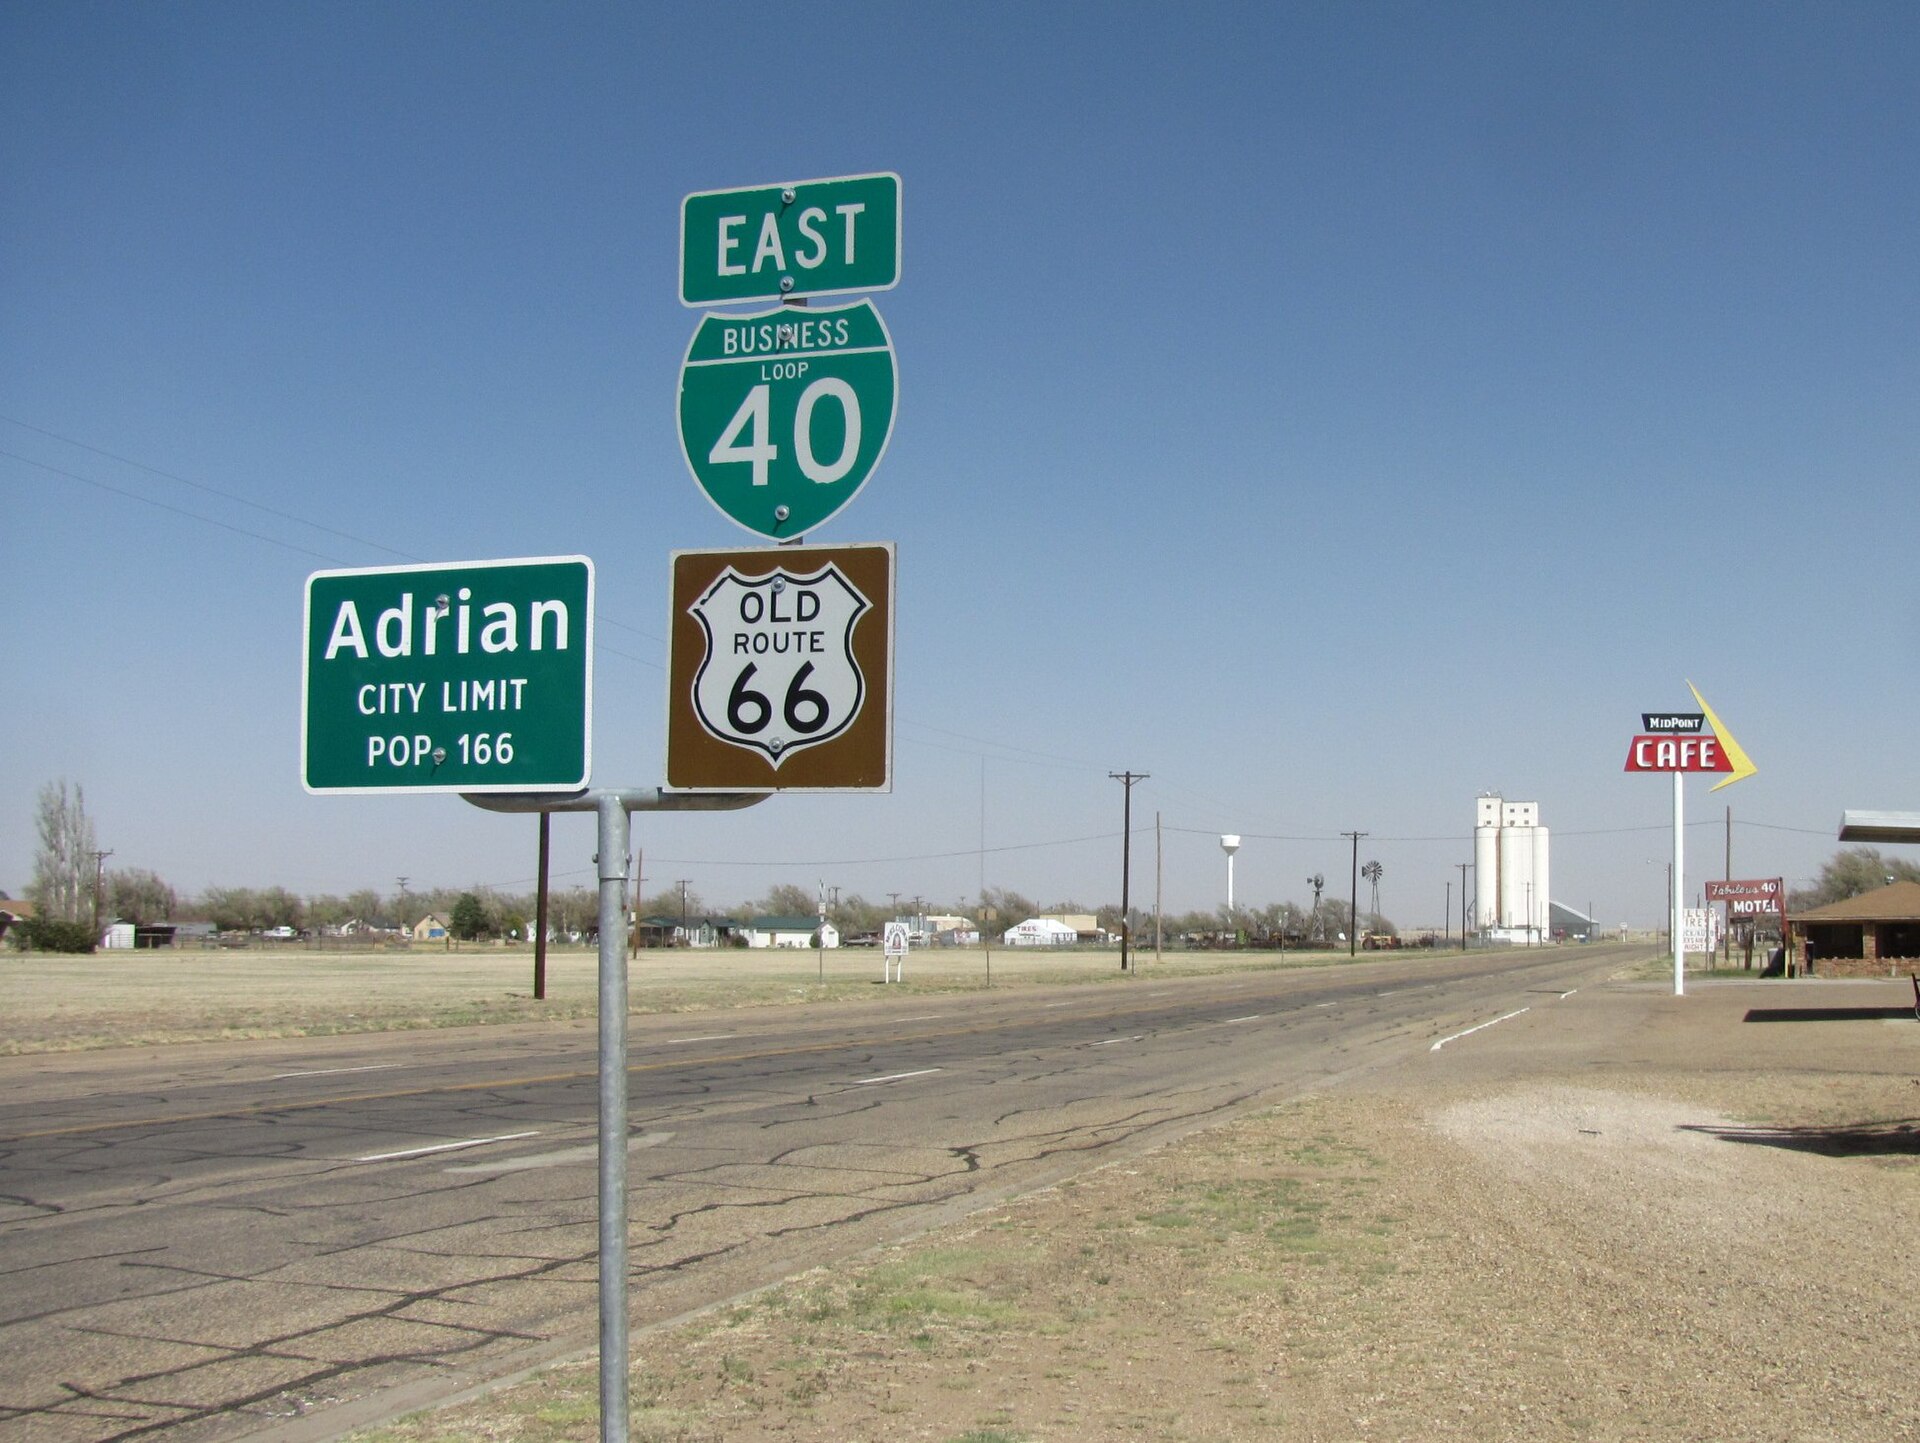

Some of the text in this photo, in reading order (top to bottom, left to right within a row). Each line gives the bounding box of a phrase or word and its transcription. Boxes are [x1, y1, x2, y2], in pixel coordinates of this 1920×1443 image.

[718, 203, 865, 276] EAST
[724, 319, 849, 354] BUSINESS
[761, 362, 809, 381] LOOP
[708, 377, 862, 486] 40
[325, 587, 568, 660] Adrian
[740, 590, 821, 624] OLD
[734, 631, 825, 654] ROUTE
[358, 678, 528, 715] CITY LIMIT
[727, 660, 830, 734] 66
[368, 732, 514, 767] POP 166
[1636, 739, 1716, 768] CAFE
[1711, 882, 1777, 895] Fabulous 40
[1732, 899, 1780, 913] MOTEL
